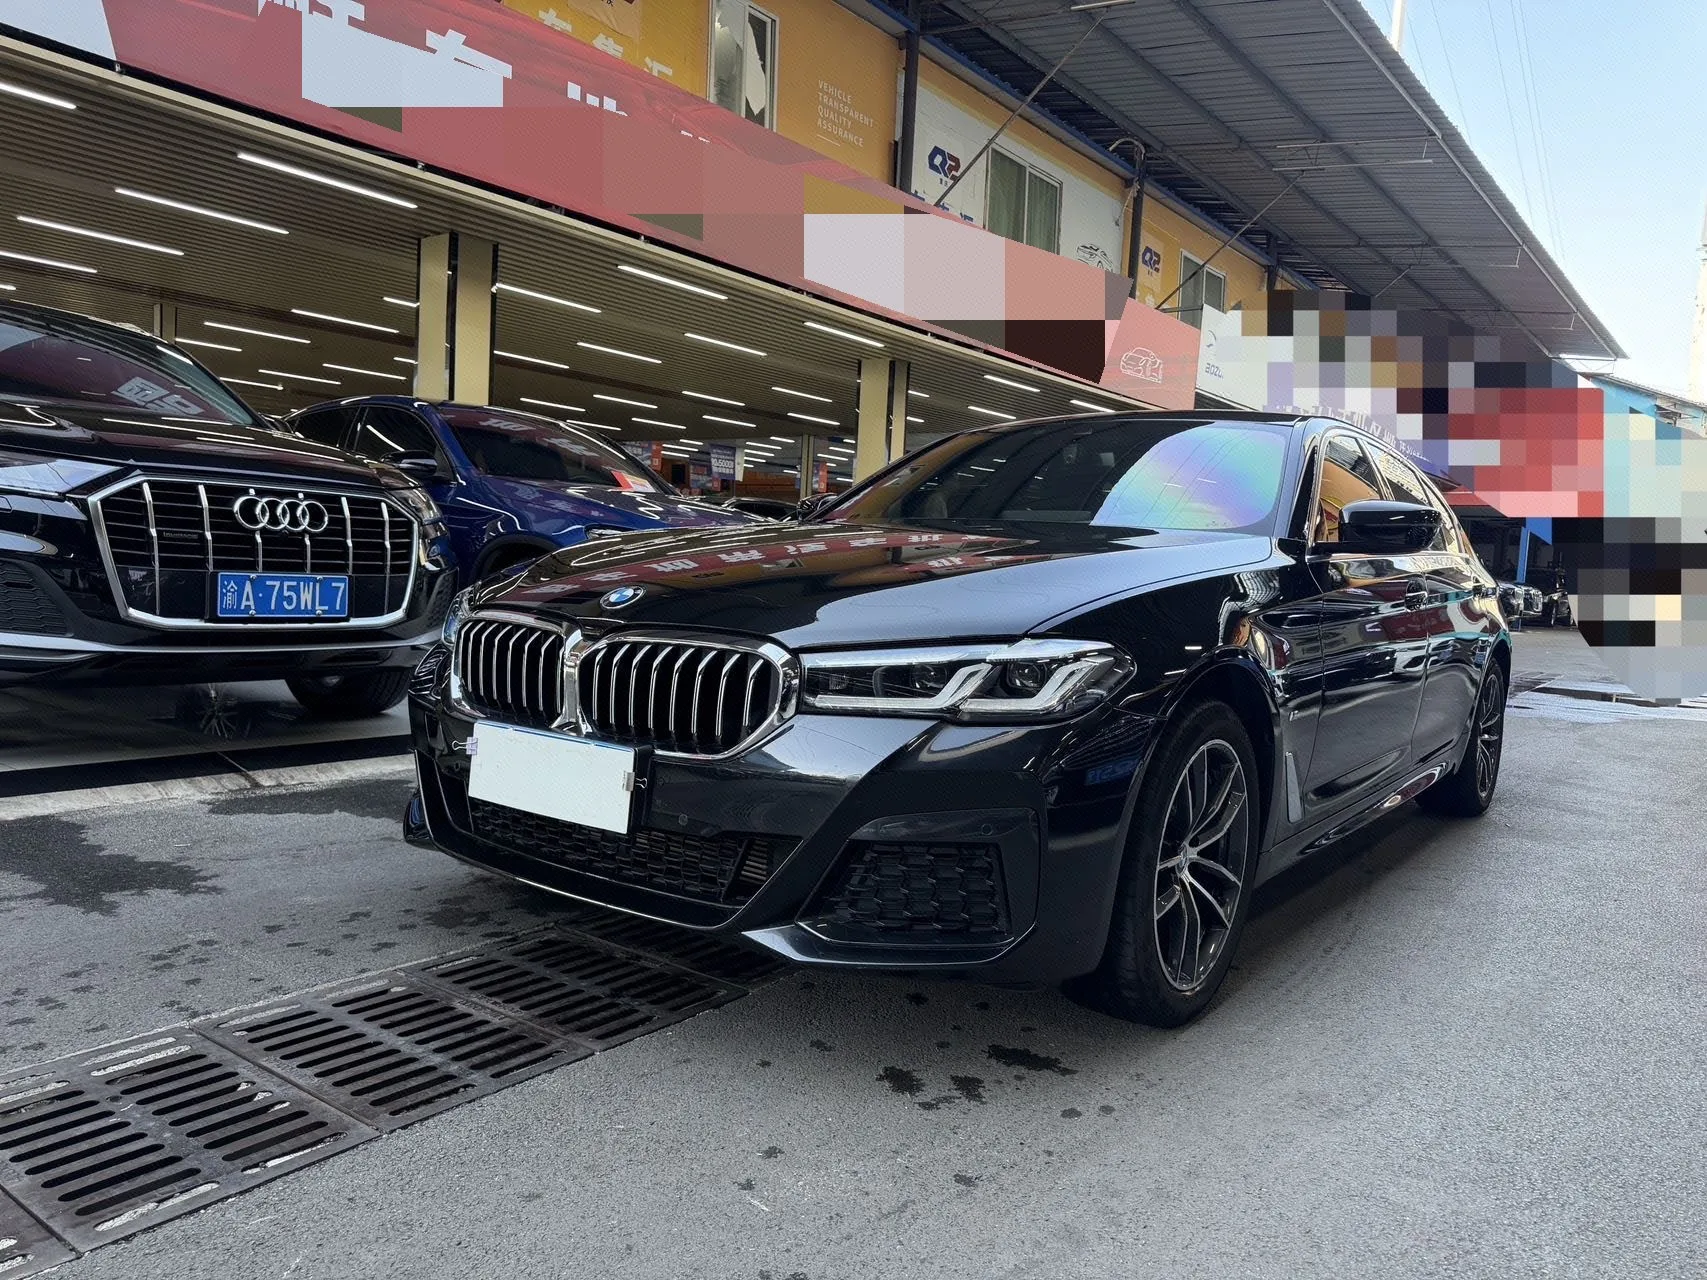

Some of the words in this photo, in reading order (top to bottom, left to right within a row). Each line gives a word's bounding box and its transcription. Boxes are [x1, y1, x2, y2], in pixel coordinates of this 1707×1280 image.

[818, 80, 852, 104] VEHICLE
[817, 92, 874, 127] TRANSPARENT
[817, 105, 852, 128] QUALITY
[817, 118, 865, 147] ASSURANCE
[221, 580, 346, 611] 渝A·75WL7
